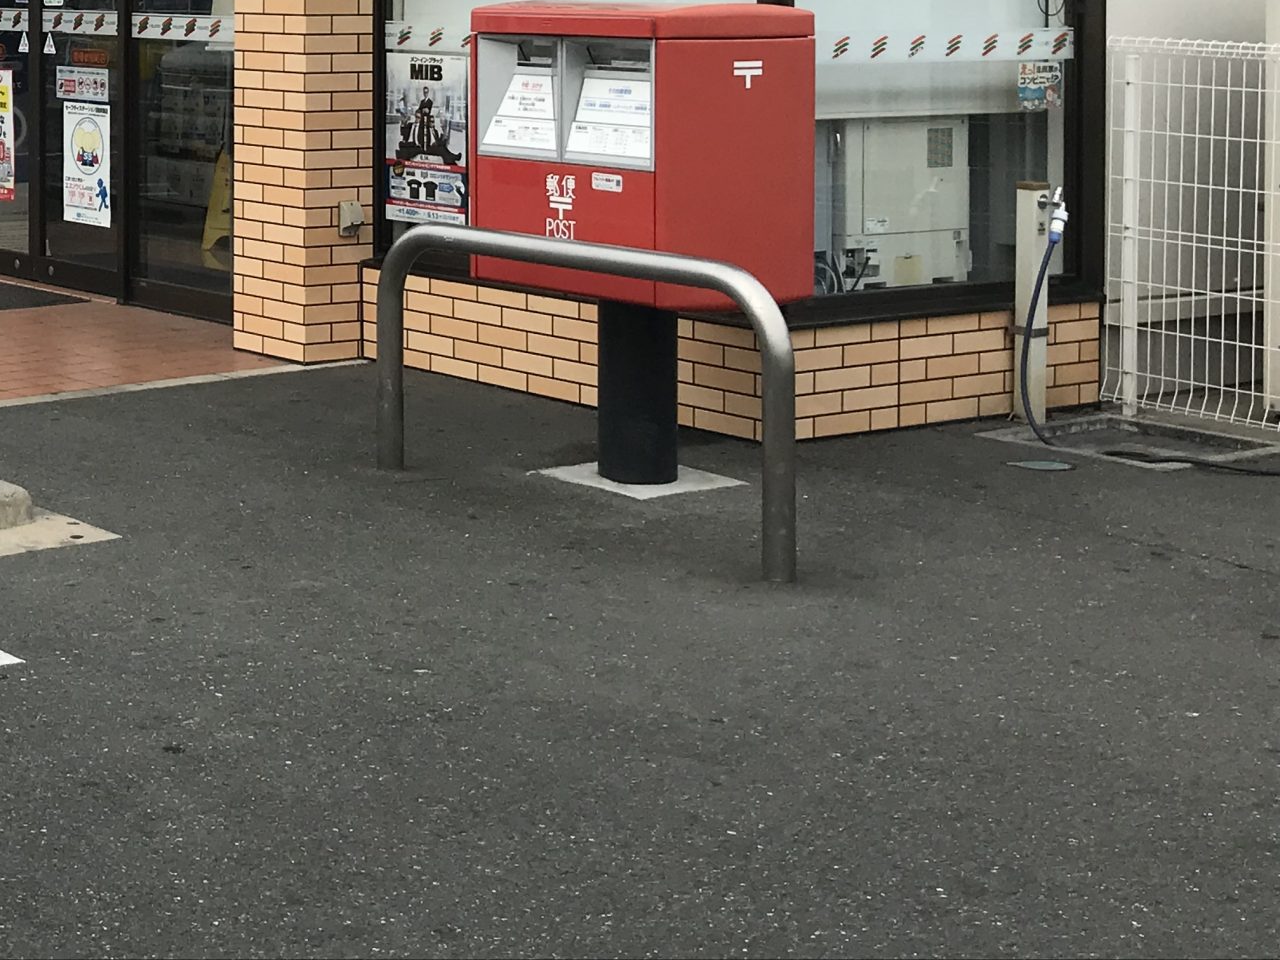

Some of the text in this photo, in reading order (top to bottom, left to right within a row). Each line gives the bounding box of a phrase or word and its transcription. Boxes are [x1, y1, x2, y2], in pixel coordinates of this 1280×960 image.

[410, 63, 443, 81] MIB
[545, 173, 576, 199] 郵便
[545, 217, 577, 240] POST
